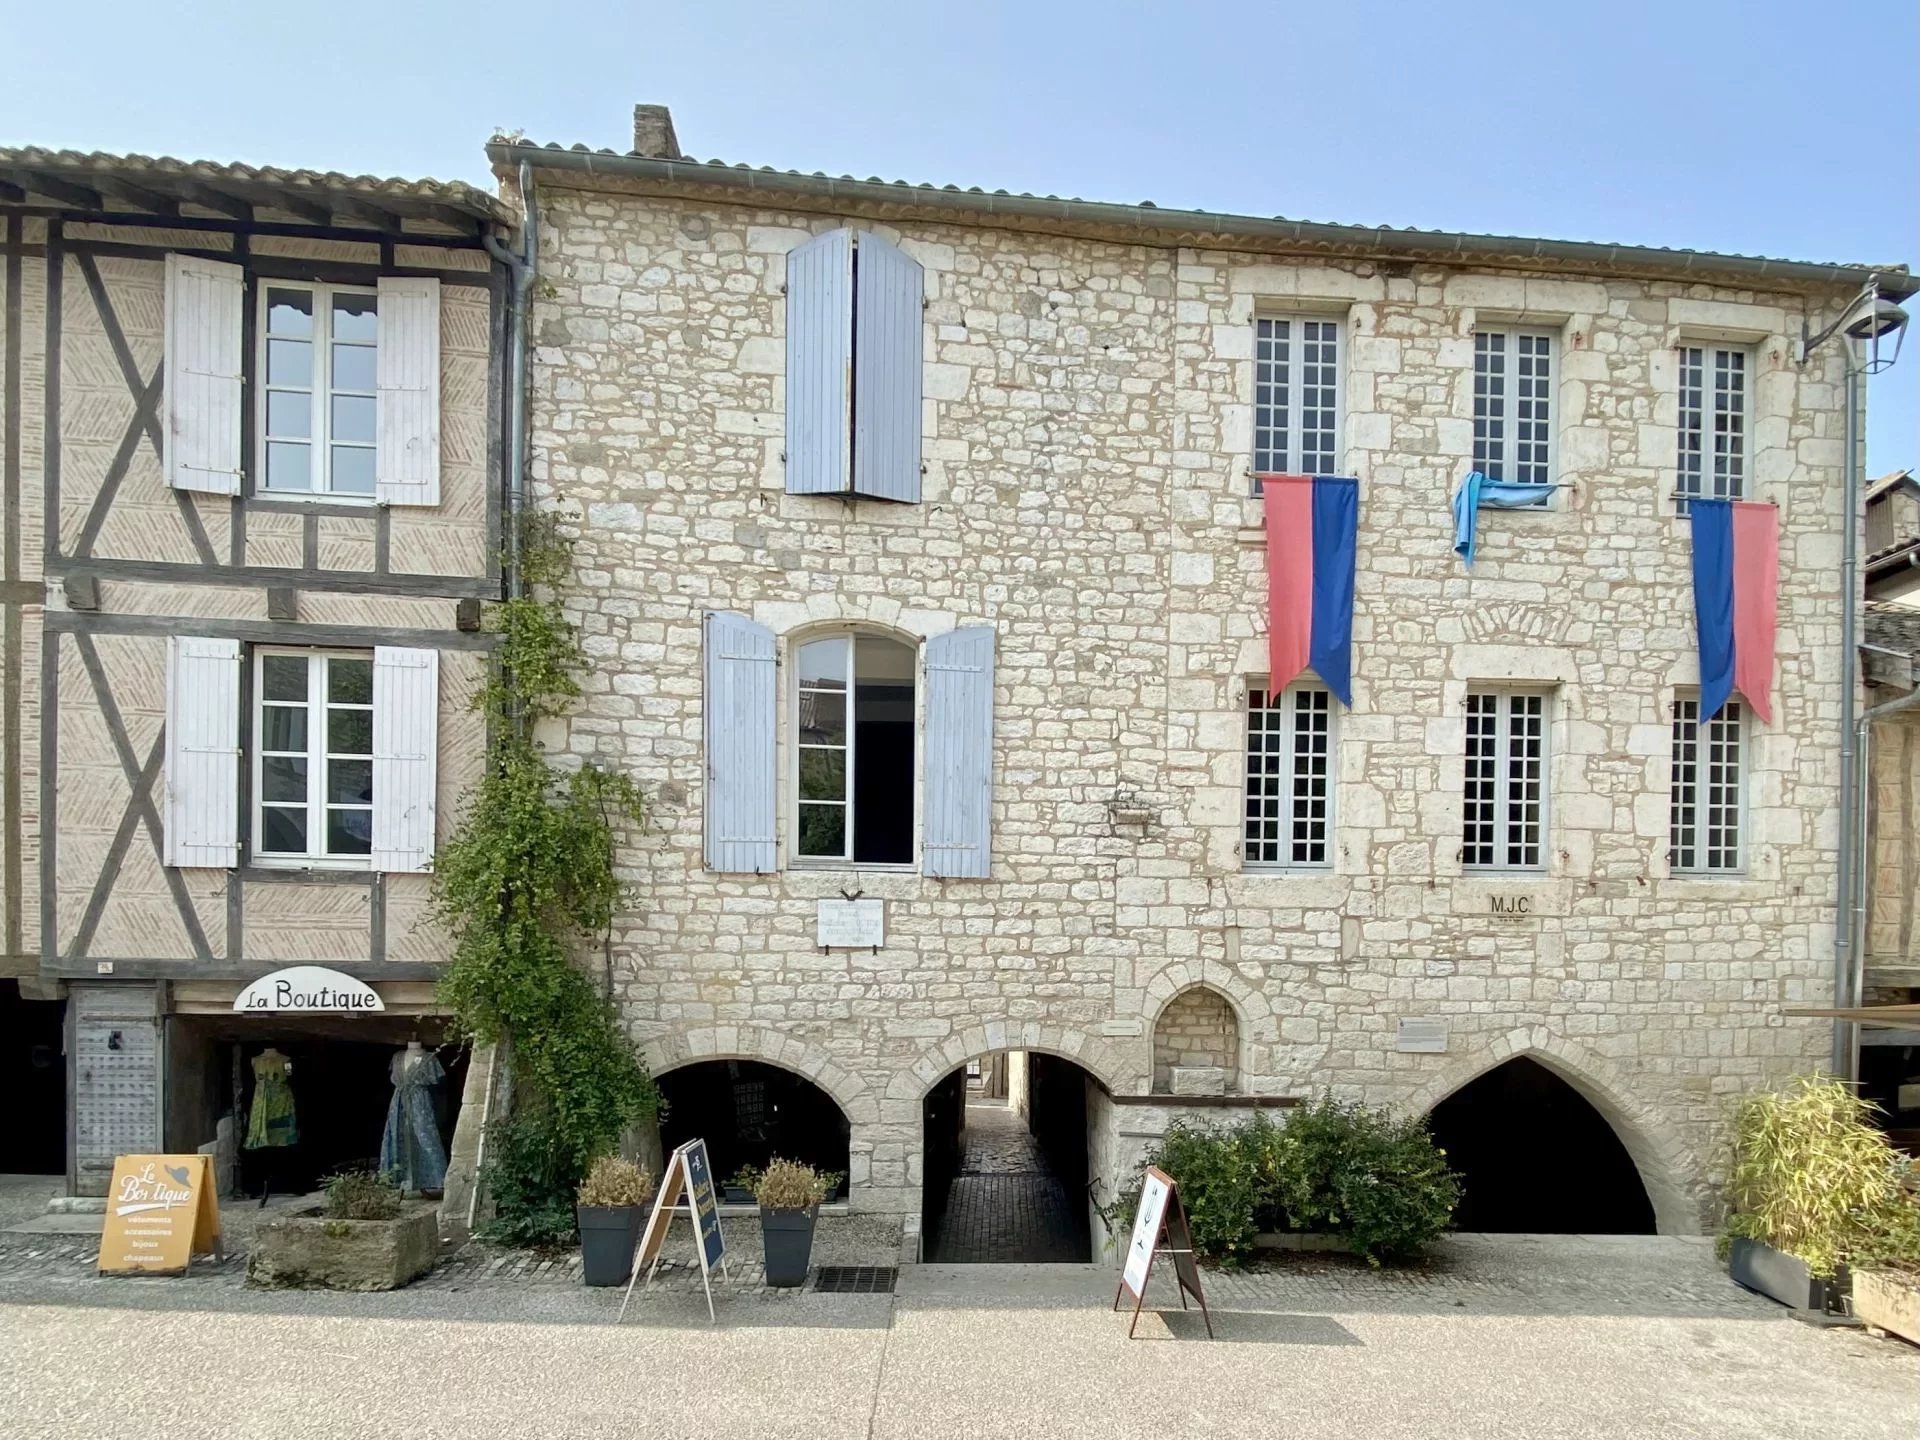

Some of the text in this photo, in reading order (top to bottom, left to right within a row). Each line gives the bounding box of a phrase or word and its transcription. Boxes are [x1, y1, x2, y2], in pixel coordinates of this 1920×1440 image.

[1491, 896, 1532, 913] M.J.C.
[245, 980, 376, 1010] La Boutique
[139, 1162, 156, 1184] La
